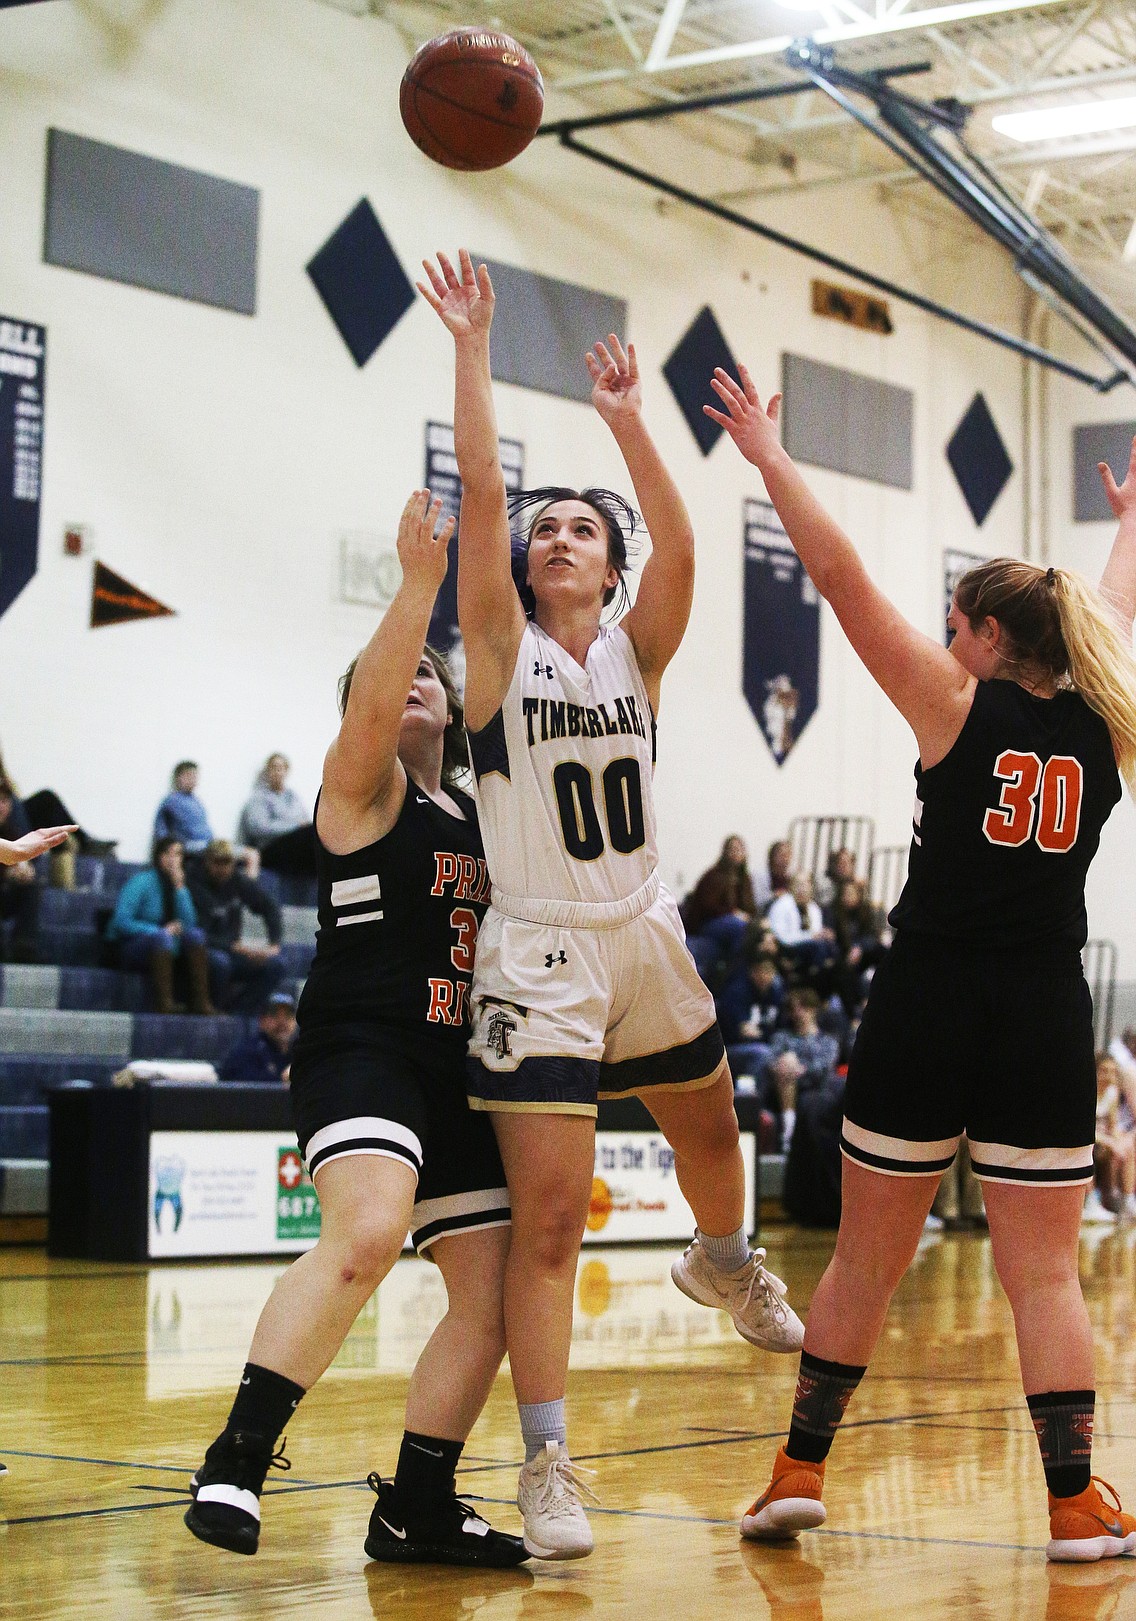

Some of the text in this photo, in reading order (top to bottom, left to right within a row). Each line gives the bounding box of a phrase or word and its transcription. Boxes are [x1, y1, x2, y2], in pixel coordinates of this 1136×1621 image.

[552, 755, 646, 863] 00
[982, 749, 1084, 853] 30
[426, 978, 472, 1026] RI
